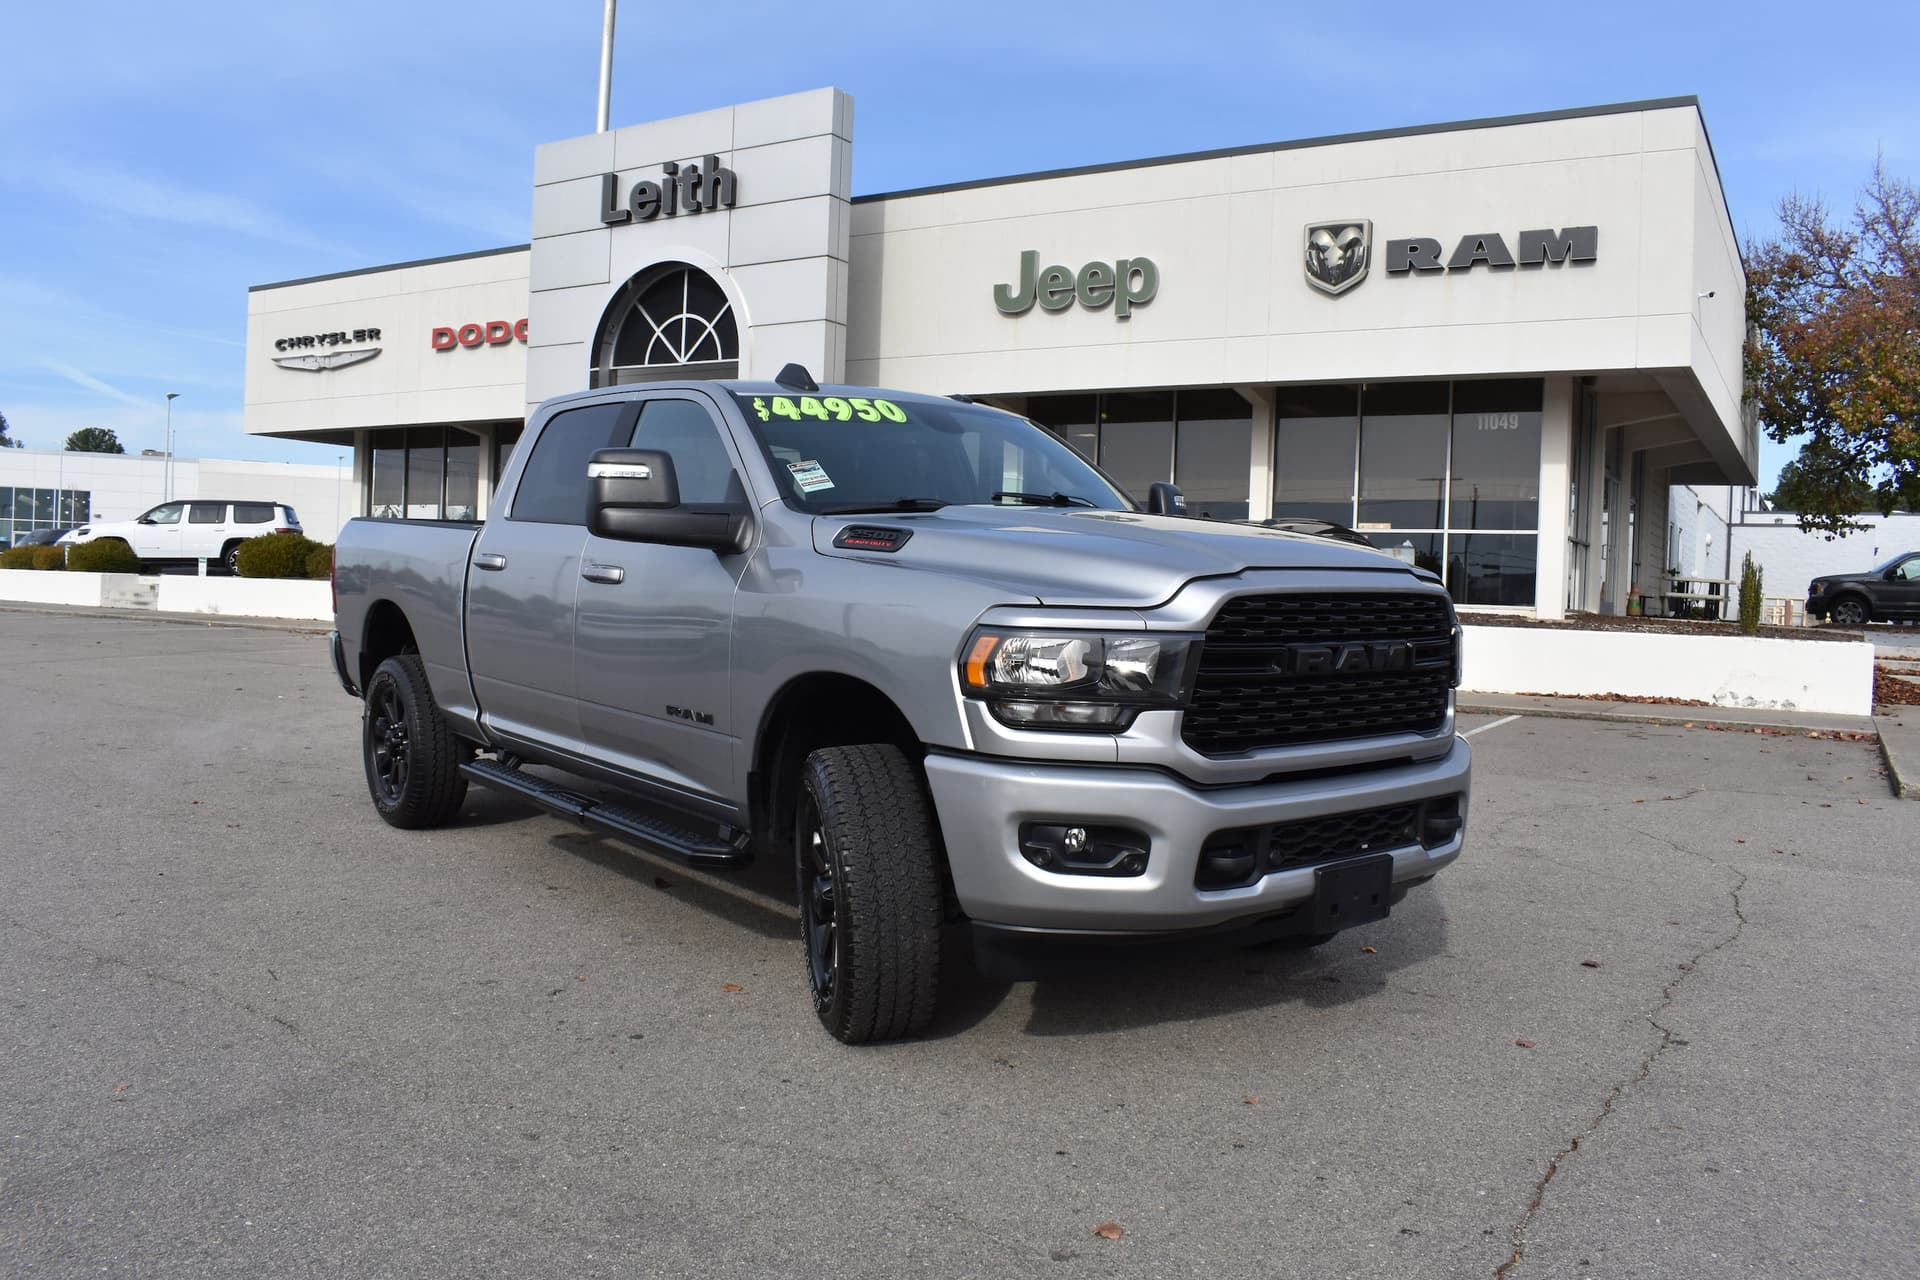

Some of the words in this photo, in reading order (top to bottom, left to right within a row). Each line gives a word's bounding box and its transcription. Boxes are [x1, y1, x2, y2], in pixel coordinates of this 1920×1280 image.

[601, 154, 736, 225] Leith
[1386, 226, 1598, 274] RAM
[993, 250, 1159, 319] Jeep
[275, 328, 381, 352] CHRYSLER
[753, 396, 908, 423] $44950
[1478, 413, 1519, 430] 11049
[848, 529, 897, 540] 2500
[1296, 641, 1406, 673] RAM
[666, 704, 714, 726] RAM
